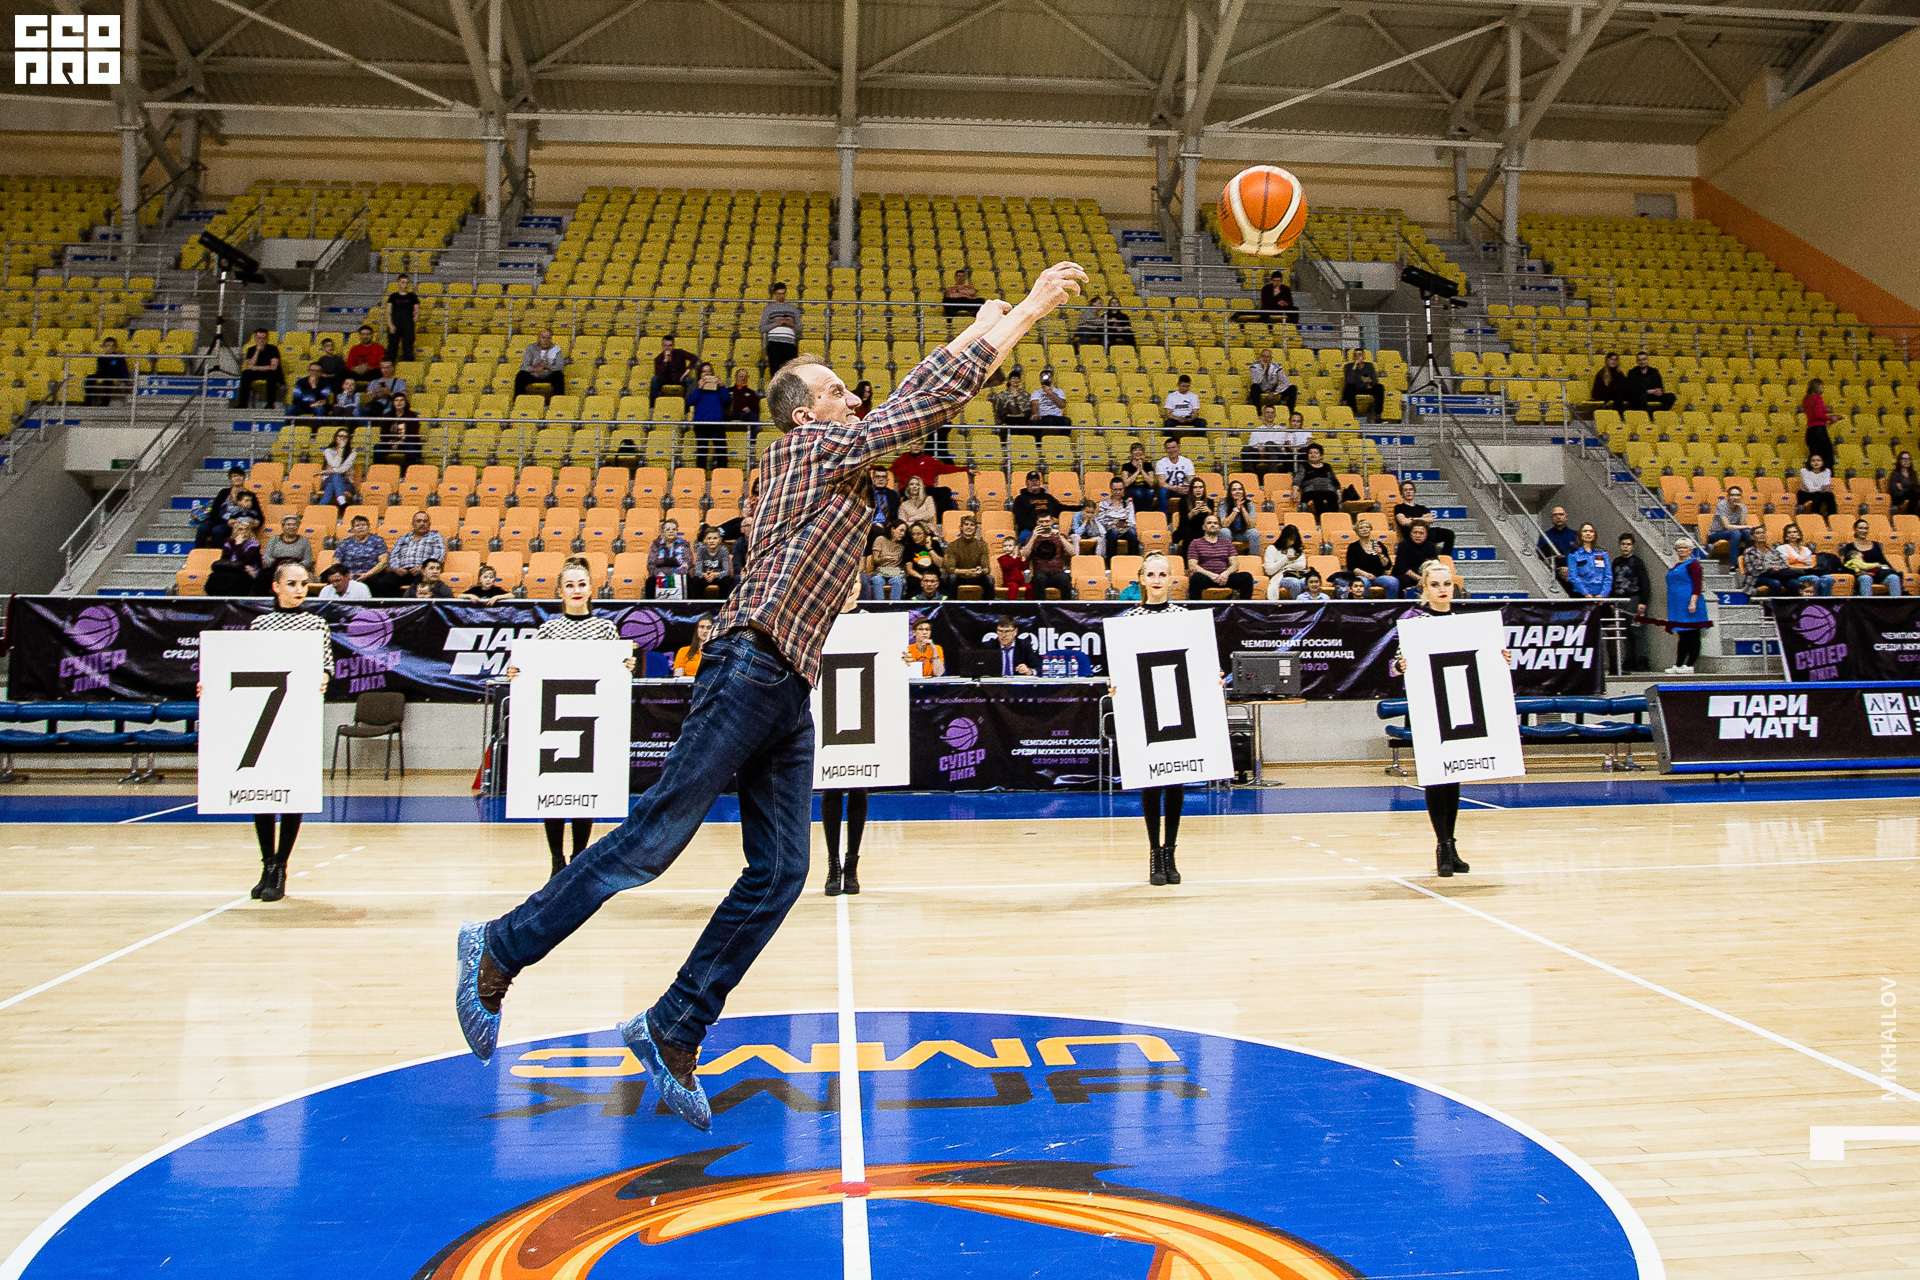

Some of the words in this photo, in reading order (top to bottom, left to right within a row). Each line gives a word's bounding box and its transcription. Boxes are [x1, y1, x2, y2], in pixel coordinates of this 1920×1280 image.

[1723, 594, 1732, 604] 2
[1240, 638, 1302, 648] ЧЕМПИОНАТ
[1303, 638, 1343, 647] РОССИИ
[1503, 624, 1588, 648] ПАРИ
[1312, 650, 1355, 660] КОМАНД
[1509, 647, 1595, 670] МАТЧ
[1795, 642, 1849, 671] СУПЕР
[821, 651, 879, 750] 0
[1136, 648, 1197, 747] 0
[1428, 649, 1489, 745] 0
[1707, 694, 1808, 717] ПАРИ
[230, 670, 292, 772] 7
[539, 679, 601, 777] 5
[1718, 716, 1819, 739] МАТЧ
[938, 748, 987, 772] СУПЕР
[1148, 757, 1205, 780] MADSHOT
[1442, 756, 1497, 777] MADSHOT
[821, 763, 881, 782] MADSHOT
[948, 766, 977, 782] ЛИГА
[228, 788, 293, 807] MADSHOT
[537, 793, 599, 810] MADSHOT
